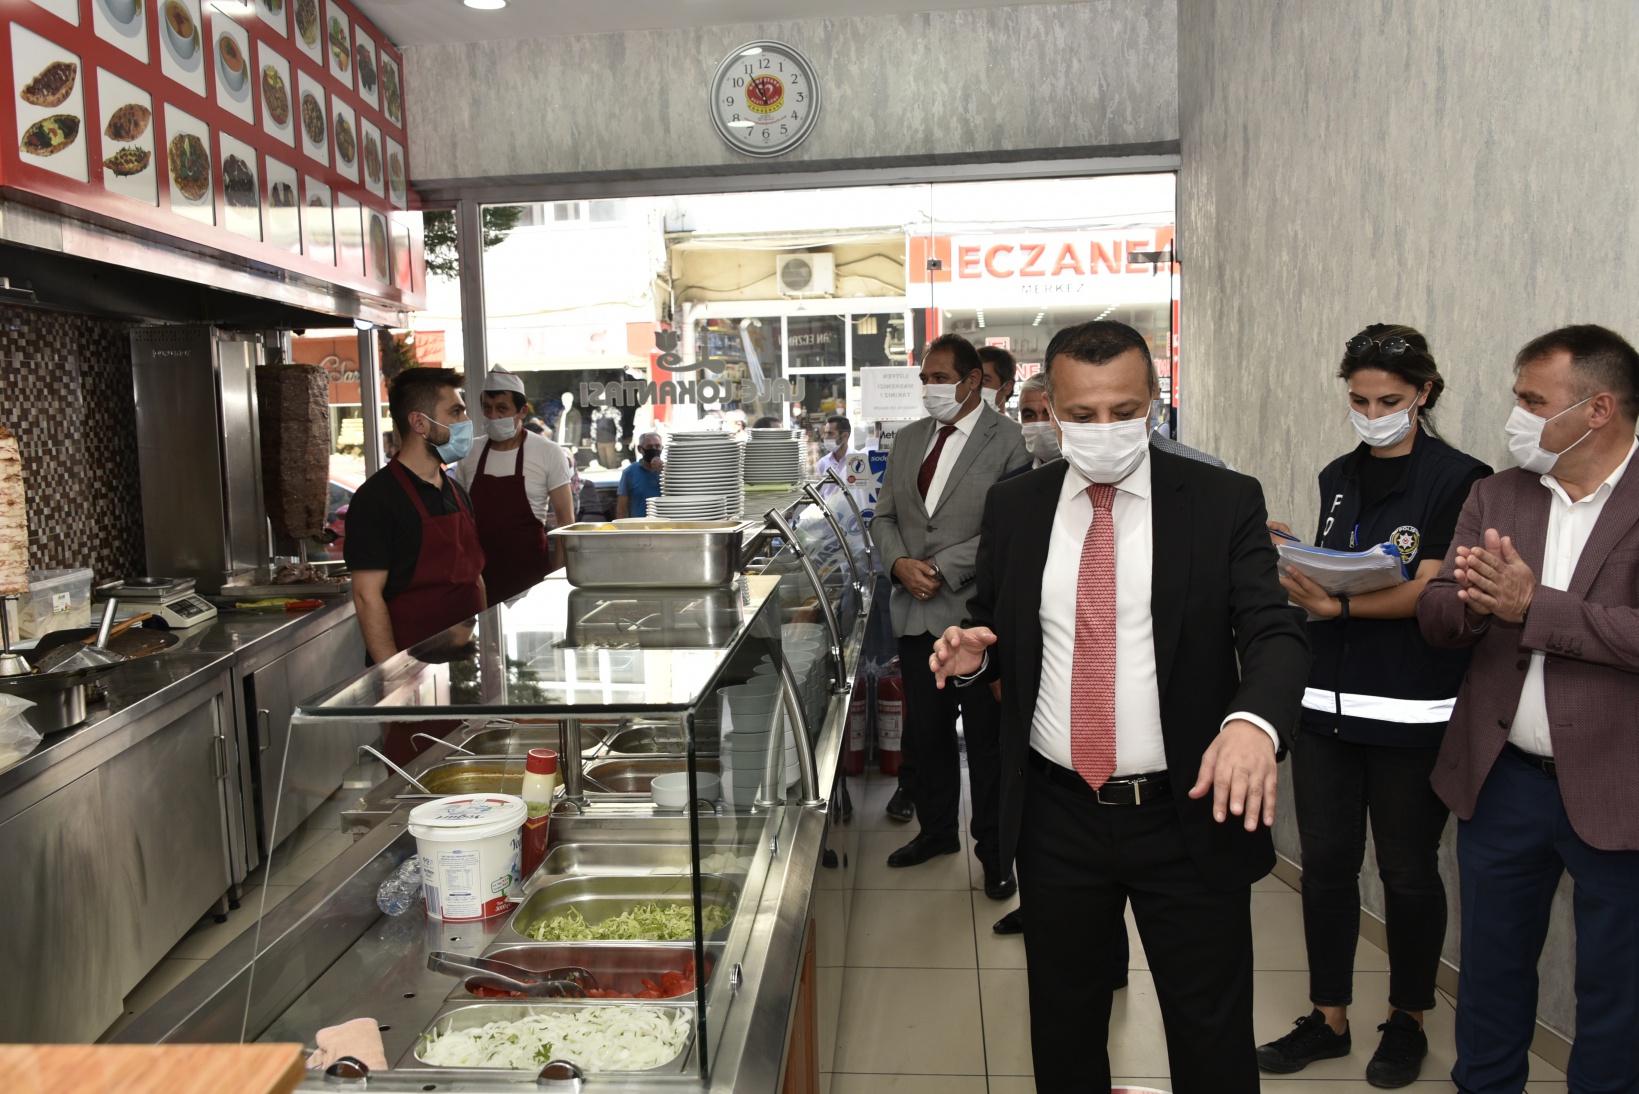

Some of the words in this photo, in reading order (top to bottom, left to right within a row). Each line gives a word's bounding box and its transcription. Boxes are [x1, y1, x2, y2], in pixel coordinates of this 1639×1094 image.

[758, 58, 771, 69] 12
[778, 62, 784, 72] 1
[744, 64, 754, 75] 11
[732, 77, 745, 88] 10
[790, 74, 799, 84] 2
[726, 96, 734, 106] 9
[796, 92, 804, 102] 3
[790, 110, 799, 120] 4
[746, 126, 754, 136] 7
[762, 128, 771, 138] 6
[780, 124, 788, 134] 5
[958, 239, 1150, 279] ECZANE
[1021, 283, 1085, 294] MERKEZ
